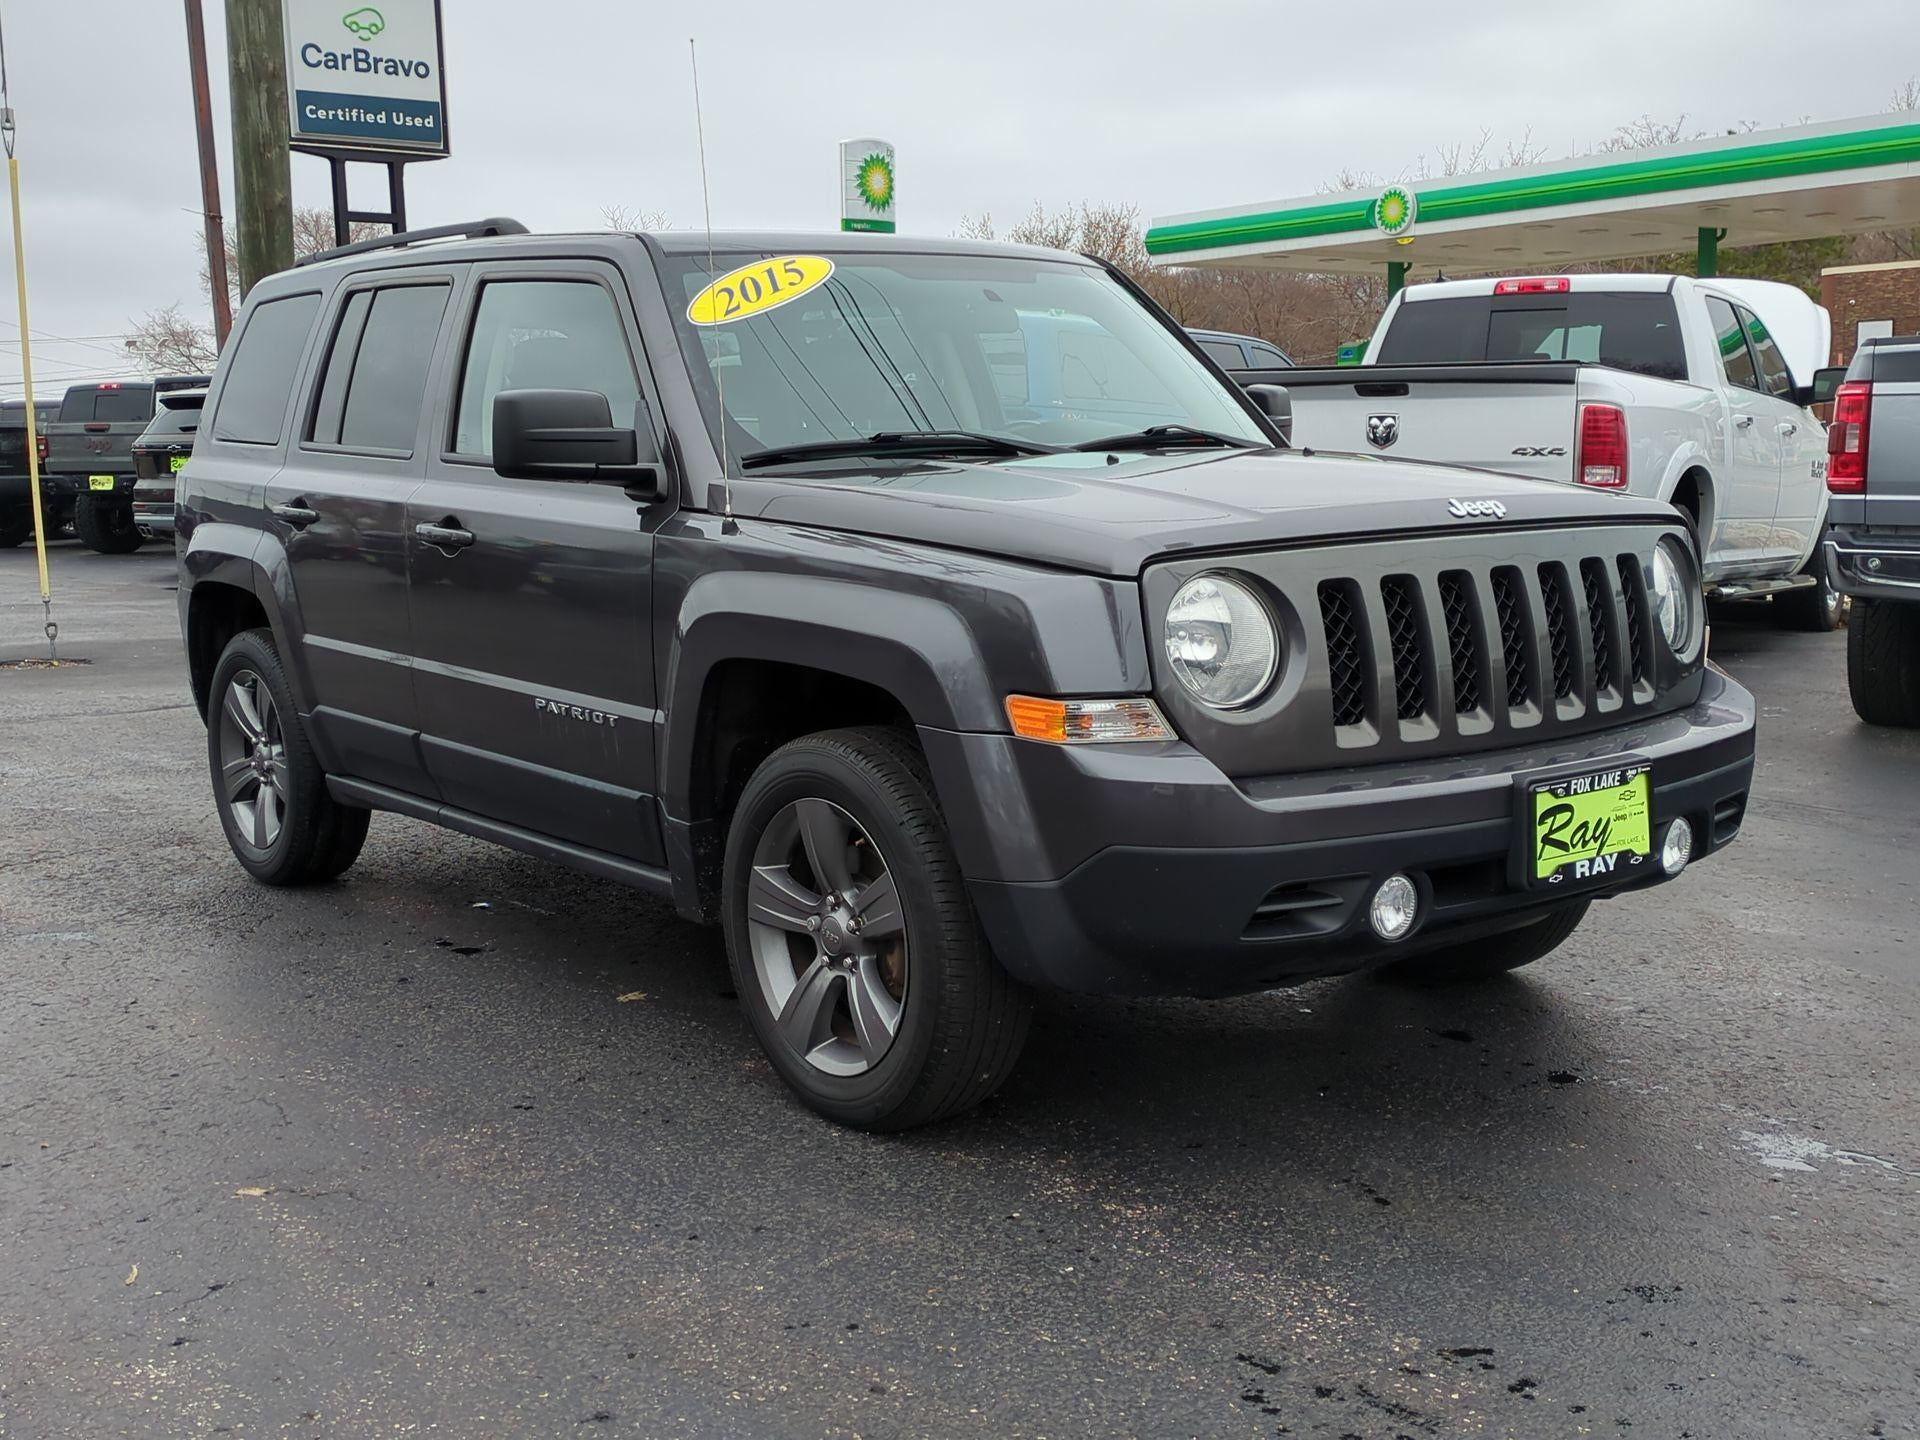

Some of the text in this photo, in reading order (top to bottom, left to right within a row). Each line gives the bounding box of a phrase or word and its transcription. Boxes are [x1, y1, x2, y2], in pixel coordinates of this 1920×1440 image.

[301, 43, 430, 79] CarBravo
[305, 105, 434, 128] Certified Used
[715, 260, 805, 317] 2015
[1448, 497, 1507, 520] Jeep
[534, 698, 619, 727] PATRIOT
[1570, 771, 1621, 795] FOX LAKE
[1613, 813, 1627, 822] Jeep
[1537, 803, 1613, 860] Ray
[1575, 853, 1618, 878] RAY
